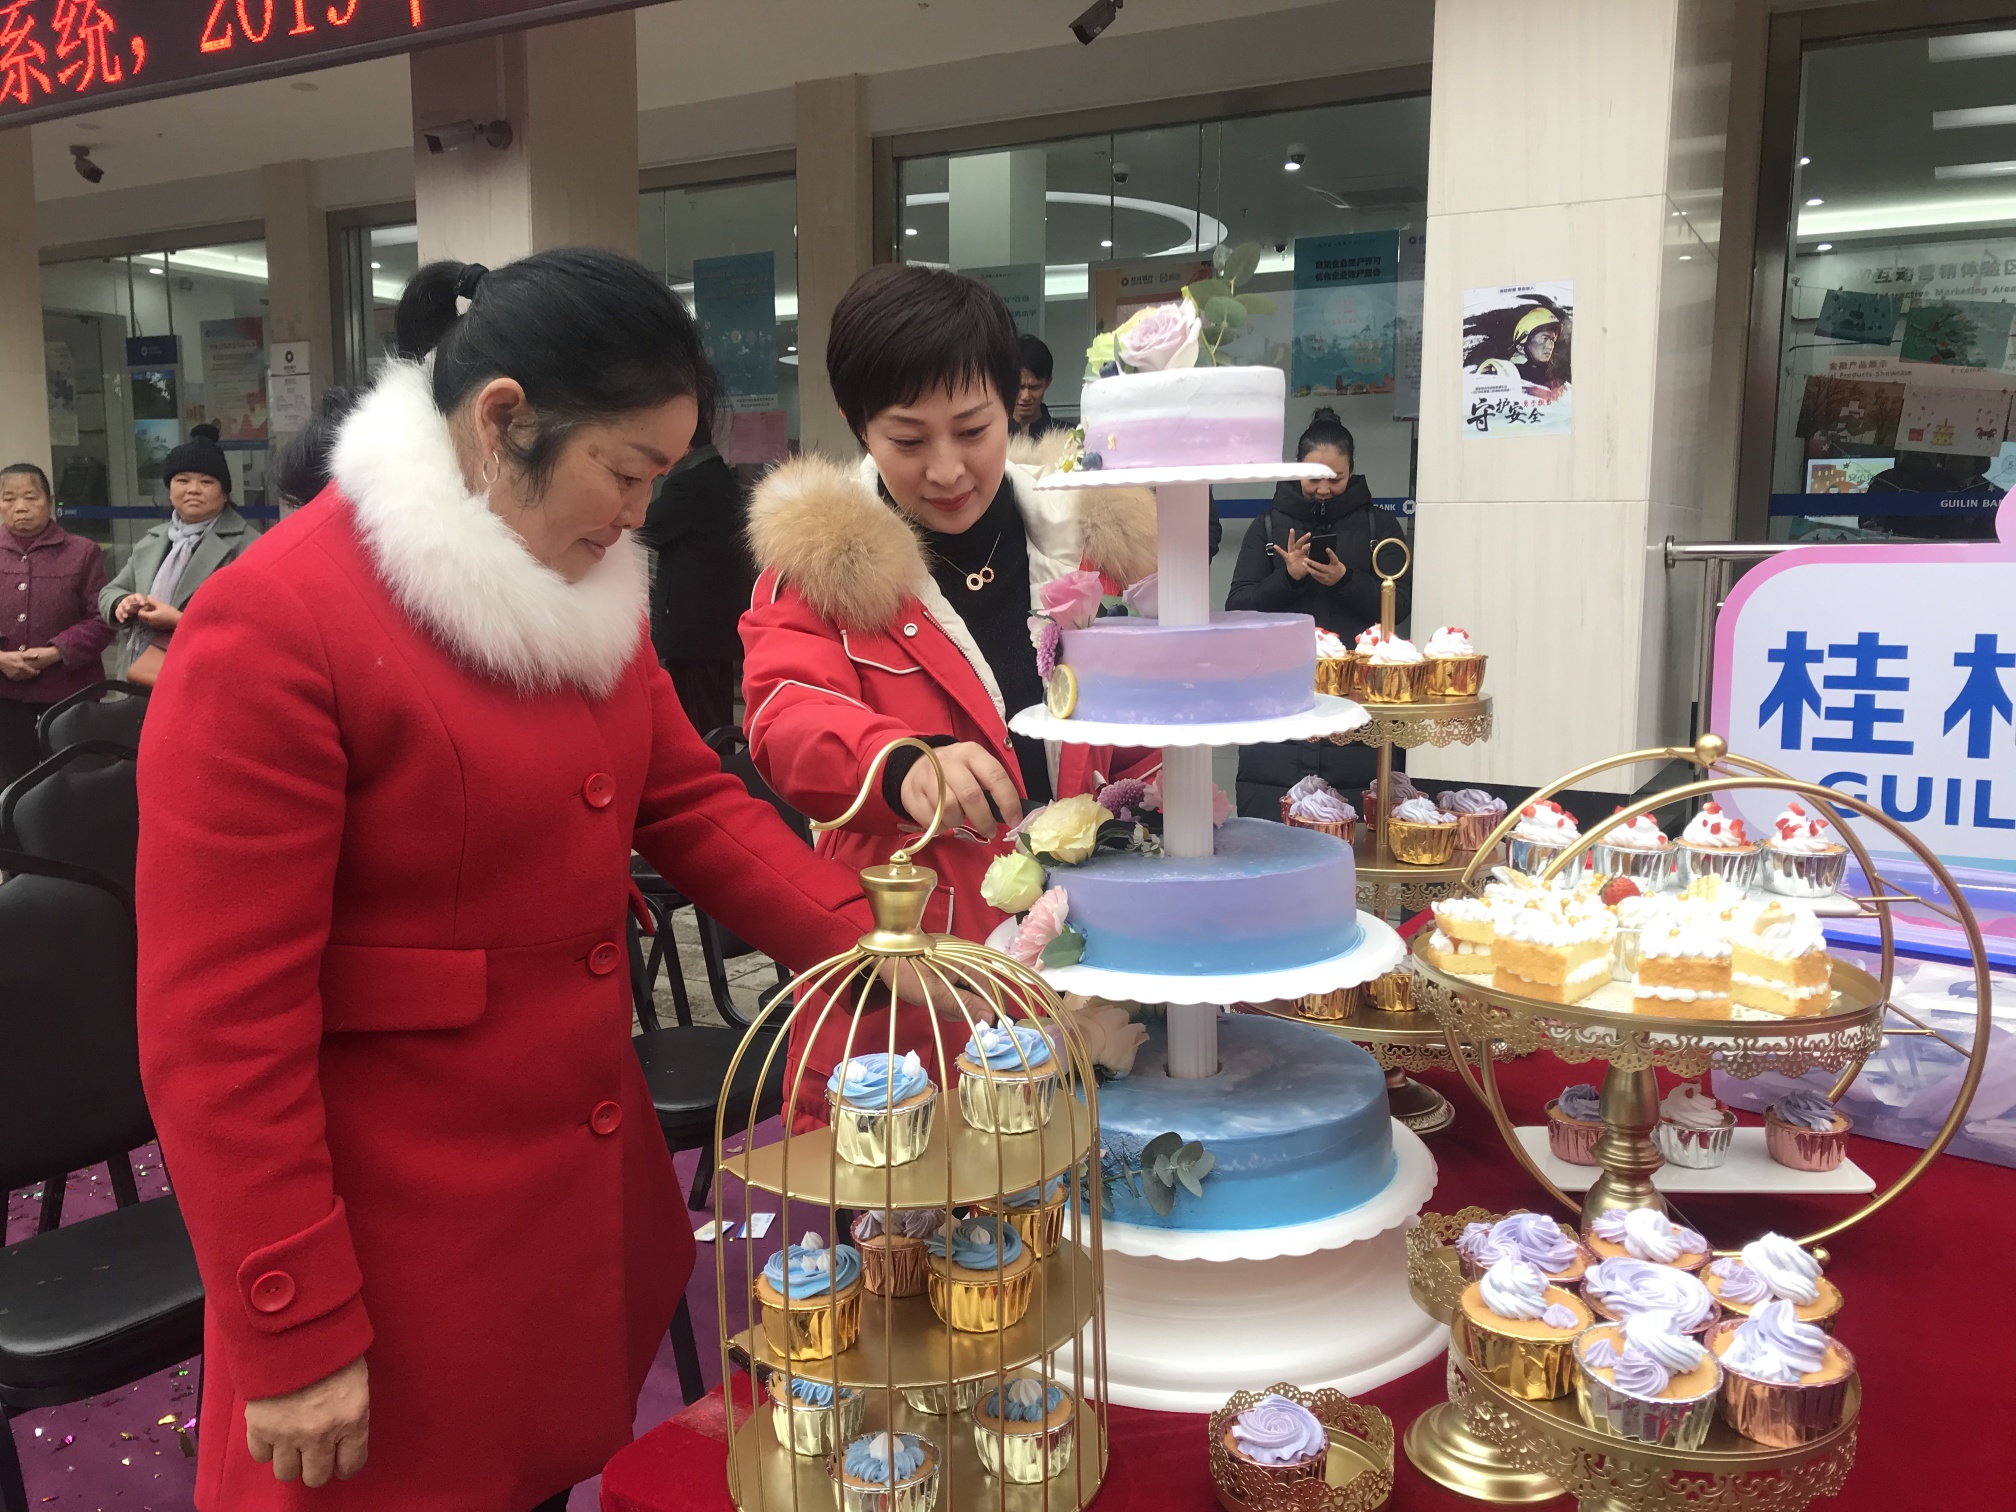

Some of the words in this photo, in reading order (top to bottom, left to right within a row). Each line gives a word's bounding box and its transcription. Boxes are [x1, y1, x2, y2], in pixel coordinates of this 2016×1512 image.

[1466, 397, 1545, 432] 守护安全
[1940, 499, 1978, 508] GUILIN
[1982, 499, 2003, 508] BA
